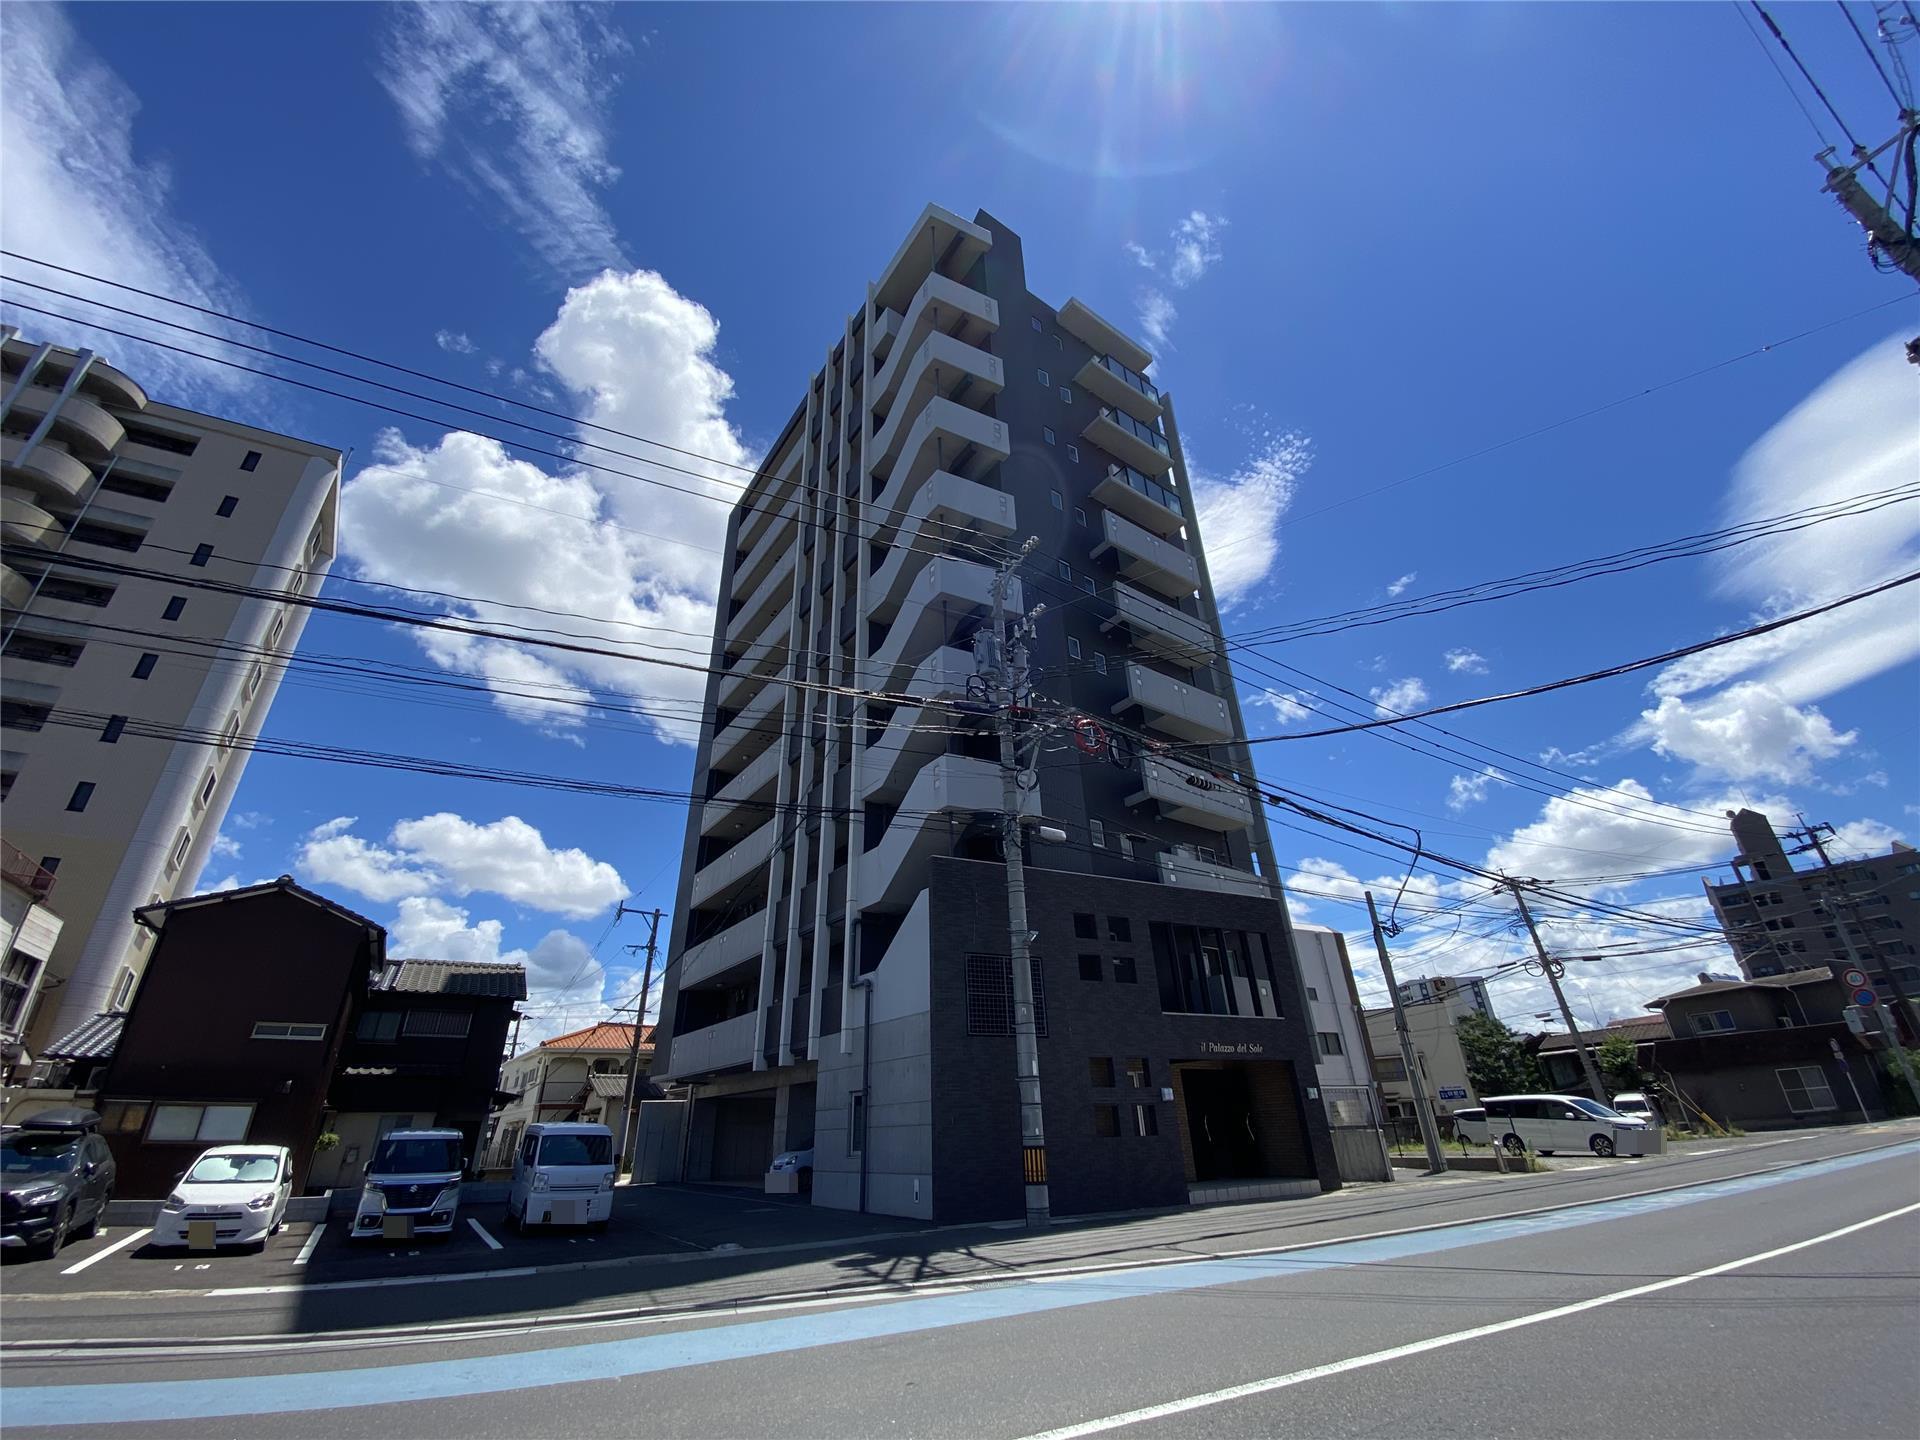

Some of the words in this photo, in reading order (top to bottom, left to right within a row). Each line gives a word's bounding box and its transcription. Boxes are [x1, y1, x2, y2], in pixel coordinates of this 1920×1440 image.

[1850, 975, 1862, 984] 40
[1200, 1042, 1206, 1053] il
[1208, 1042, 1235, 1053] Palazzo
[1236, 1043, 1247, 1053] del
[1248, 1043, 1263, 1053] Sole
